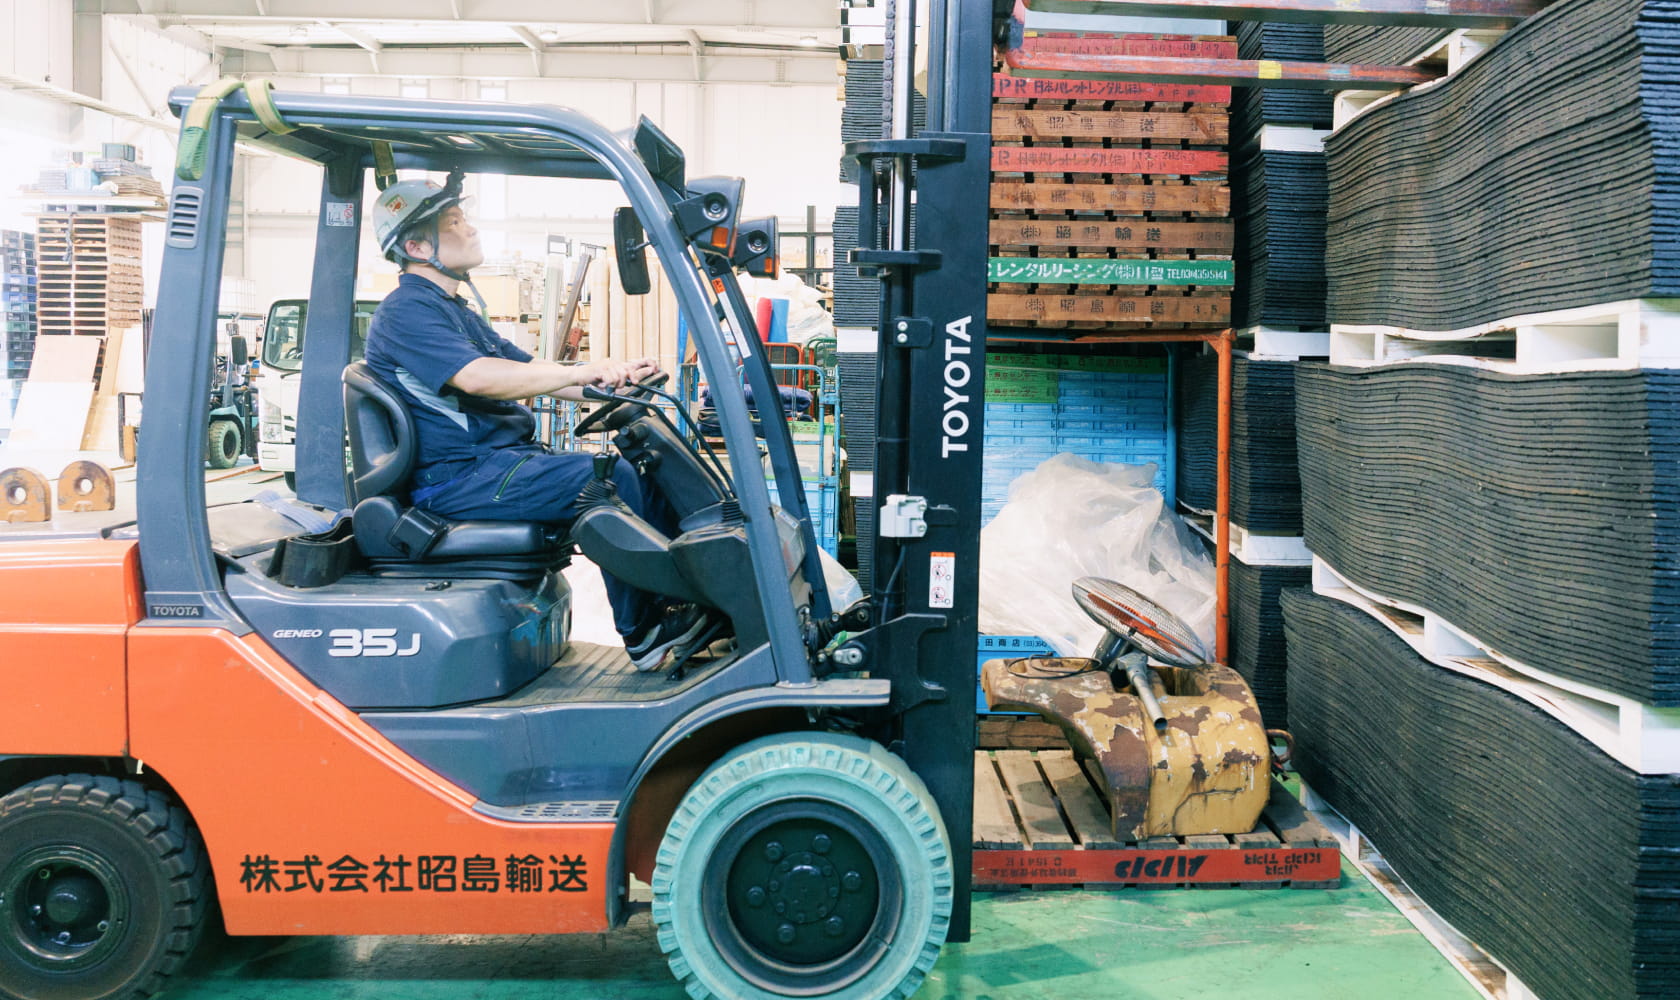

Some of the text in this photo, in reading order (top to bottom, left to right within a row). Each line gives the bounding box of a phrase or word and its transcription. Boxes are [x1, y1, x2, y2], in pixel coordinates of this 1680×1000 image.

[987, 261, 1136, 279] レンタルリーシング(株)
[942, 315, 972, 458] TOYOTA
[153, 606, 200, 617] TOYOTA
[272, 628, 421, 657] GENEO 35J
[239, 854, 589, 893] 株式会社昭島輸送
